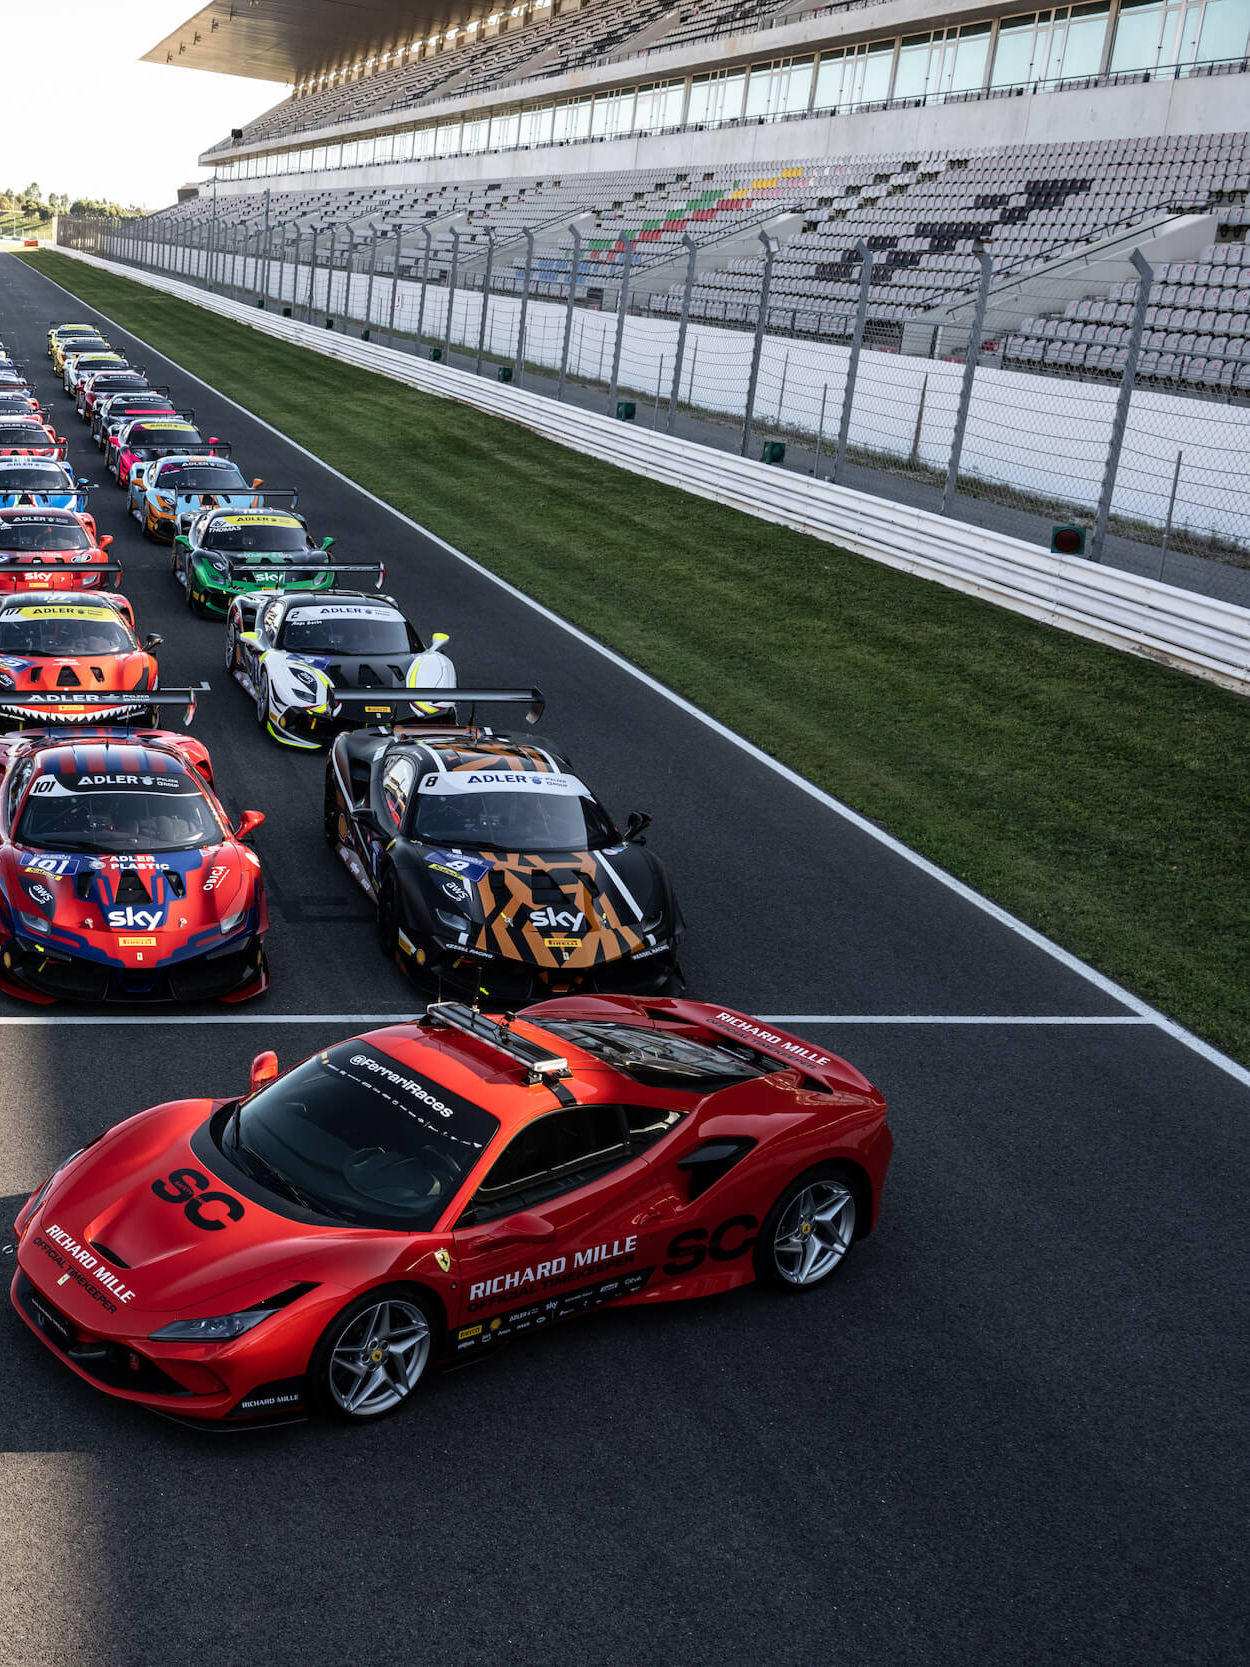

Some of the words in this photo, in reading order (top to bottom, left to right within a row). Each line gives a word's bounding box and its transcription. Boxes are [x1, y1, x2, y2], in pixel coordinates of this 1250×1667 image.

[24, 572, 52, 581] sky
[255, 572, 284, 583] sky
[291, 611, 300, 619] 2
[27, 694, 100, 702] ADLER
[33, 781, 56, 793] 101
[78, 775, 138, 786] ADLER
[425, 776, 438, 787] 8
[468, 775, 527, 784] ADLER
[28, 859, 69, 875] 101
[33, 883, 53, 902] aws
[446, 881, 469, 900] aws
[108, 906, 163, 931] sky
[529, 907, 584, 931] sky
[716, 1012, 782, 1044] RICHARD
[780, 1042, 830, 1066] MILLE
[350, 1054, 454, 1118] @FerrariRaces
[151, 1168, 245, 1231] SC
[662, 1214, 758, 1276] SC
[45, 1224, 99, 1270] RICHARD
[92, 1264, 136, 1304] MILLE
[470, 1257, 567, 1301] RICHARD
[574, 1235, 638, 1269] MILLE
[33, 1237, 66, 1269] OFFICIAL
[66, 1264, 117, 1315] TIMEKEEPER
[467, 1285, 538, 1313] OFFICIAL
[540, 1254, 635, 1290] TIMEKEEPER
[545, 1300, 559, 1311] sky
[509, 1311, 527, 1322] ADLER
[241, 1397, 275, 1408] RICHARD
[276, 1394, 299, 1403] MILLE
